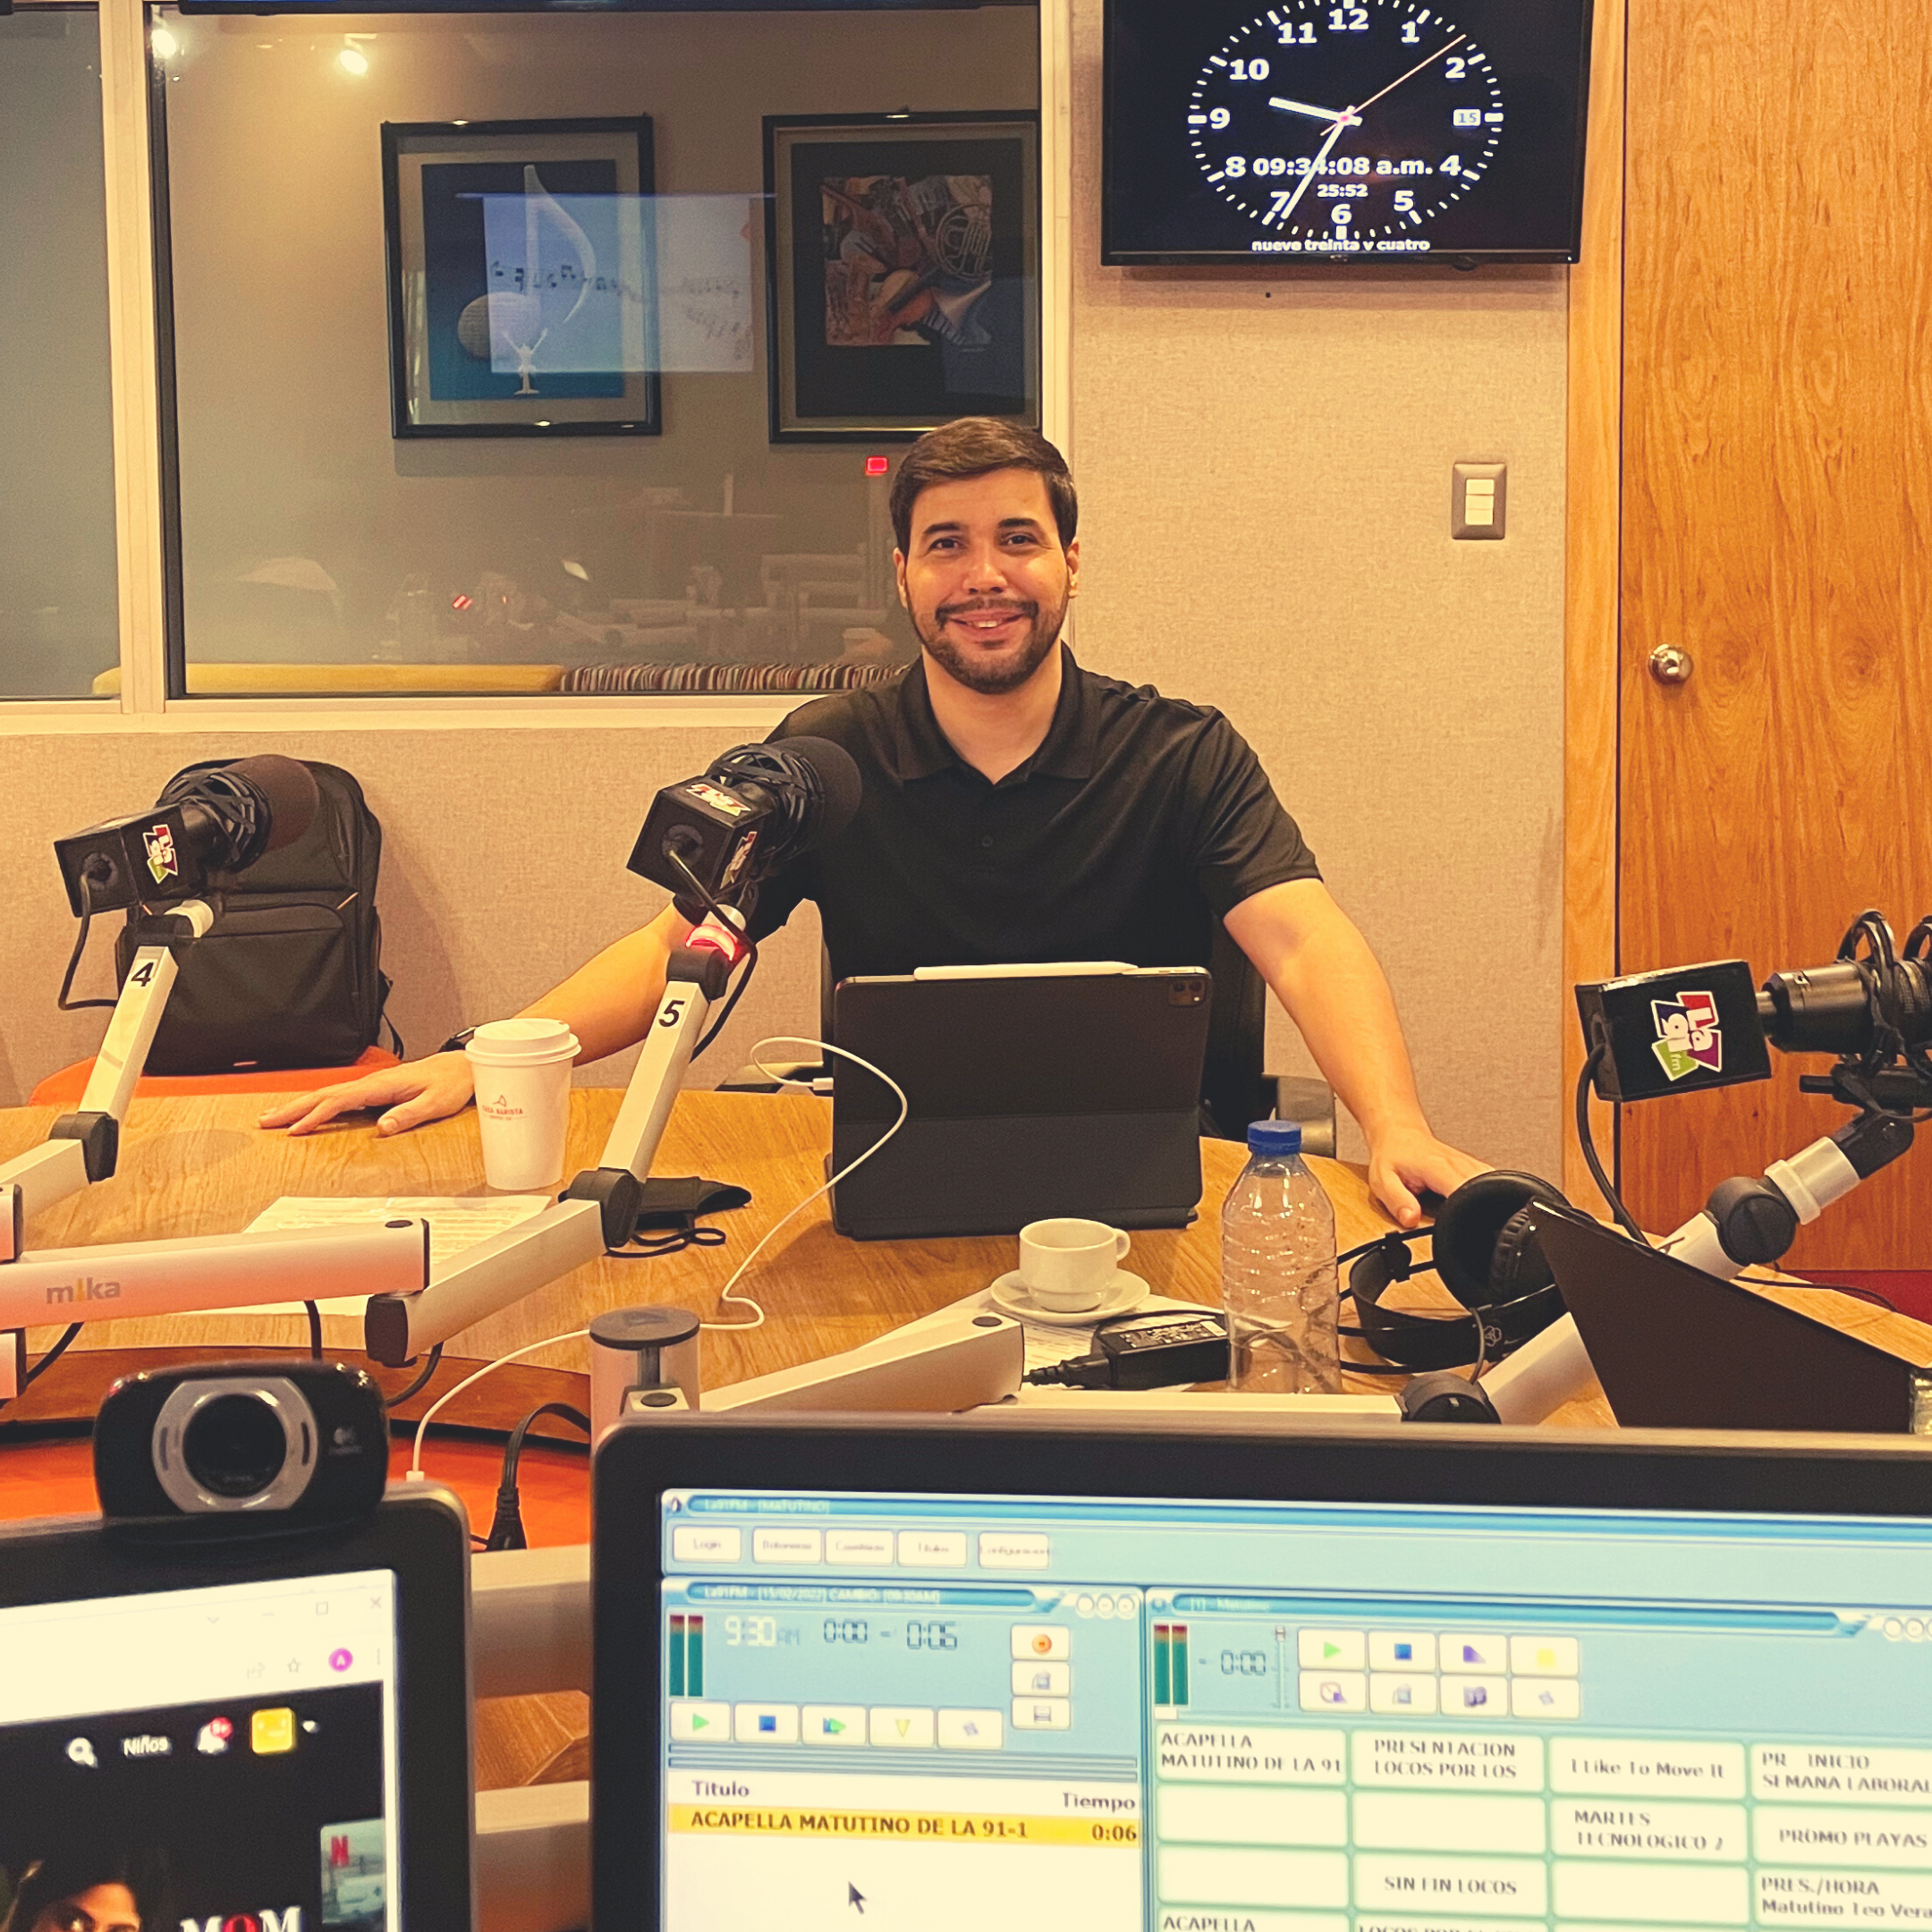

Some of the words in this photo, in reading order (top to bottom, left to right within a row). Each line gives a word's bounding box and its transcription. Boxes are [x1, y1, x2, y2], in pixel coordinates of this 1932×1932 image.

[1328, 9, 1369, 30] 12
[1277, 22, 1318, 44] 11
[1401, 22, 1419, 44] 1
[1230, 59, 1269, 80] 10
[1445, 57, 1466, 79] 2
[1209, 108, 1231, 129] 9
[1458, 112, 1477, 123] 15
[1224, 157, 1247, 177] 8
[1252, 157, 1370, 176] 09:34:08
[1376, 159, 1433, 175] a.m.
[1439, 155, 1462, 176] 4
[1317, 183, 1368, 198] 25:52
[1270, 191, 1290, 212] 7
[1393, 190, 1414, 212] 5
[1331, 203, 1352, 225] 6
[1304, 239, 1360, 251] treinta
[1376, 239, 1430, 251] cuatro
[131, 962, 154, 987] 4
[658, 999, 685, 1027] 5
[1686, 1007, 1714, 1052] La
[1670, 1054, 1682, 1072] fm
[47, 1277, 121, 1304] mika
[724, 1615, 775, 1647] 9:30
[823, 1618, 868, 1644] 0:00
[1221, 1649, 1267, 1676] 0:00
[1161, 1732, 1252, 1749] ACAPELLA
[1374, 1739, 1516, 1758] PRESENTACION
[1161, 1753, 1258, 1770] MATUTINO
[1265, 1757, 1284, 1771] DE
[1293, 1758, 1316, 1772] LA
[1322, 1758, 1341, 1773] 91
[1375, 1760, 1433, 1776] LOCOS
[1439, 1762, 1477, 1777] POR
[1482, 1764, 1517, 1779] LOS
[1584, 1759, 1622, 1775] Like
[1630, 1761, 1650, 1775] To
[1657, 1761, 1704, 1777] Move
[1808, 1753, 1870, 1770] INICIO
[1762, 1774, 1842, 1791] SEMANA
[1847, 1776, 1932, 1793] LABORAL
[1063, 1792, 1136, 1813] Tiempo
[691, 1810, 792, 1830] ACAPELLA
[800, 1814, 911, 1834] MATUTINO
[918, 1818, 944, 1835] DE
[951, 1819, 976, 1836] LA
[982, 1819, 1029, 1838] 91-1
[1575, 1809, 1651, 1826] MARTES
[1091, 1823, 1138, 1842] 0:06
[1577, 1831, 1707, 1851] TECNOLOGICO
[1779, 1828, 1848, 1845] PROMO
[1853, 1831, 1928, 1848] PLAYAS
[1385, 1876, 1415, 1891] SIN
[1421, 1877, 1452, 1893] FIN
[1458, 1879, 1517, 1895] LOCOS
[1762, 1898, 1844, 1916] Matutino
